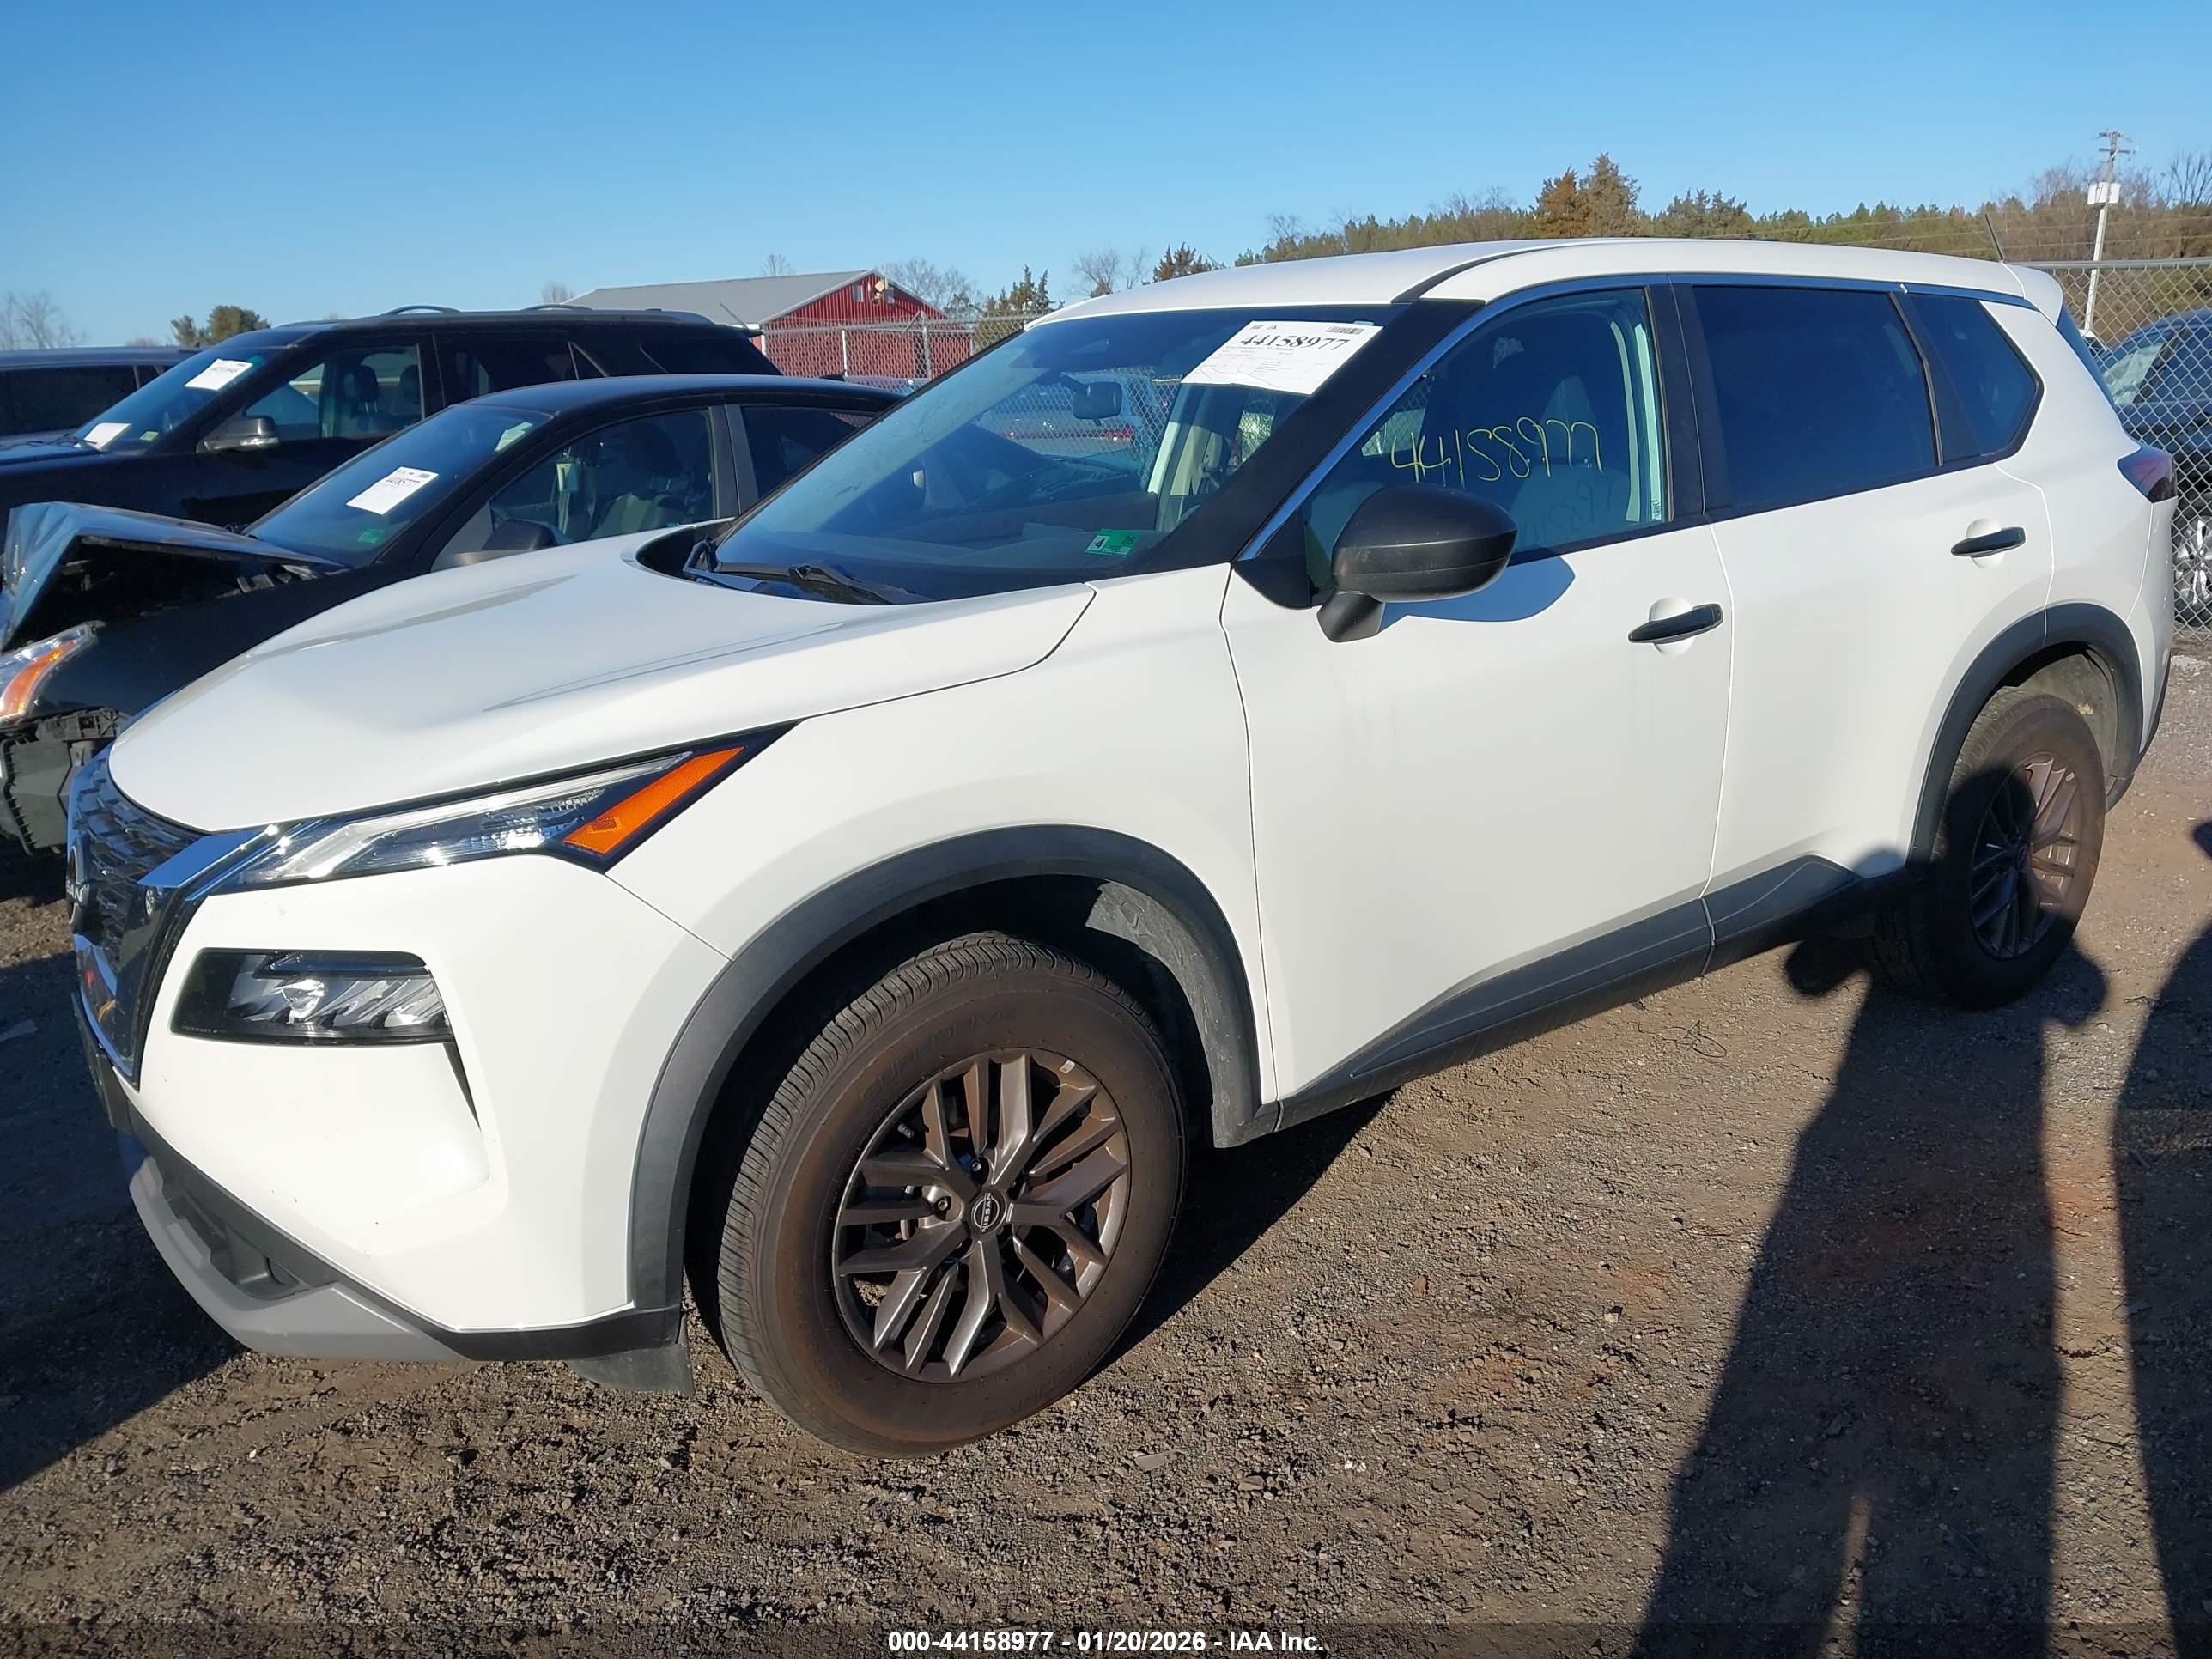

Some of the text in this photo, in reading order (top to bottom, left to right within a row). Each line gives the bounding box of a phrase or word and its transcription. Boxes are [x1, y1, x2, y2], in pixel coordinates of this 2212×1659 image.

[1240, 334, 1351, 351] 44158977
[1391, 416, 1603, 489] 44158977
[1095, 538, 1105, 549] 4
[981, 1193, 992, 1232] NISSAN
